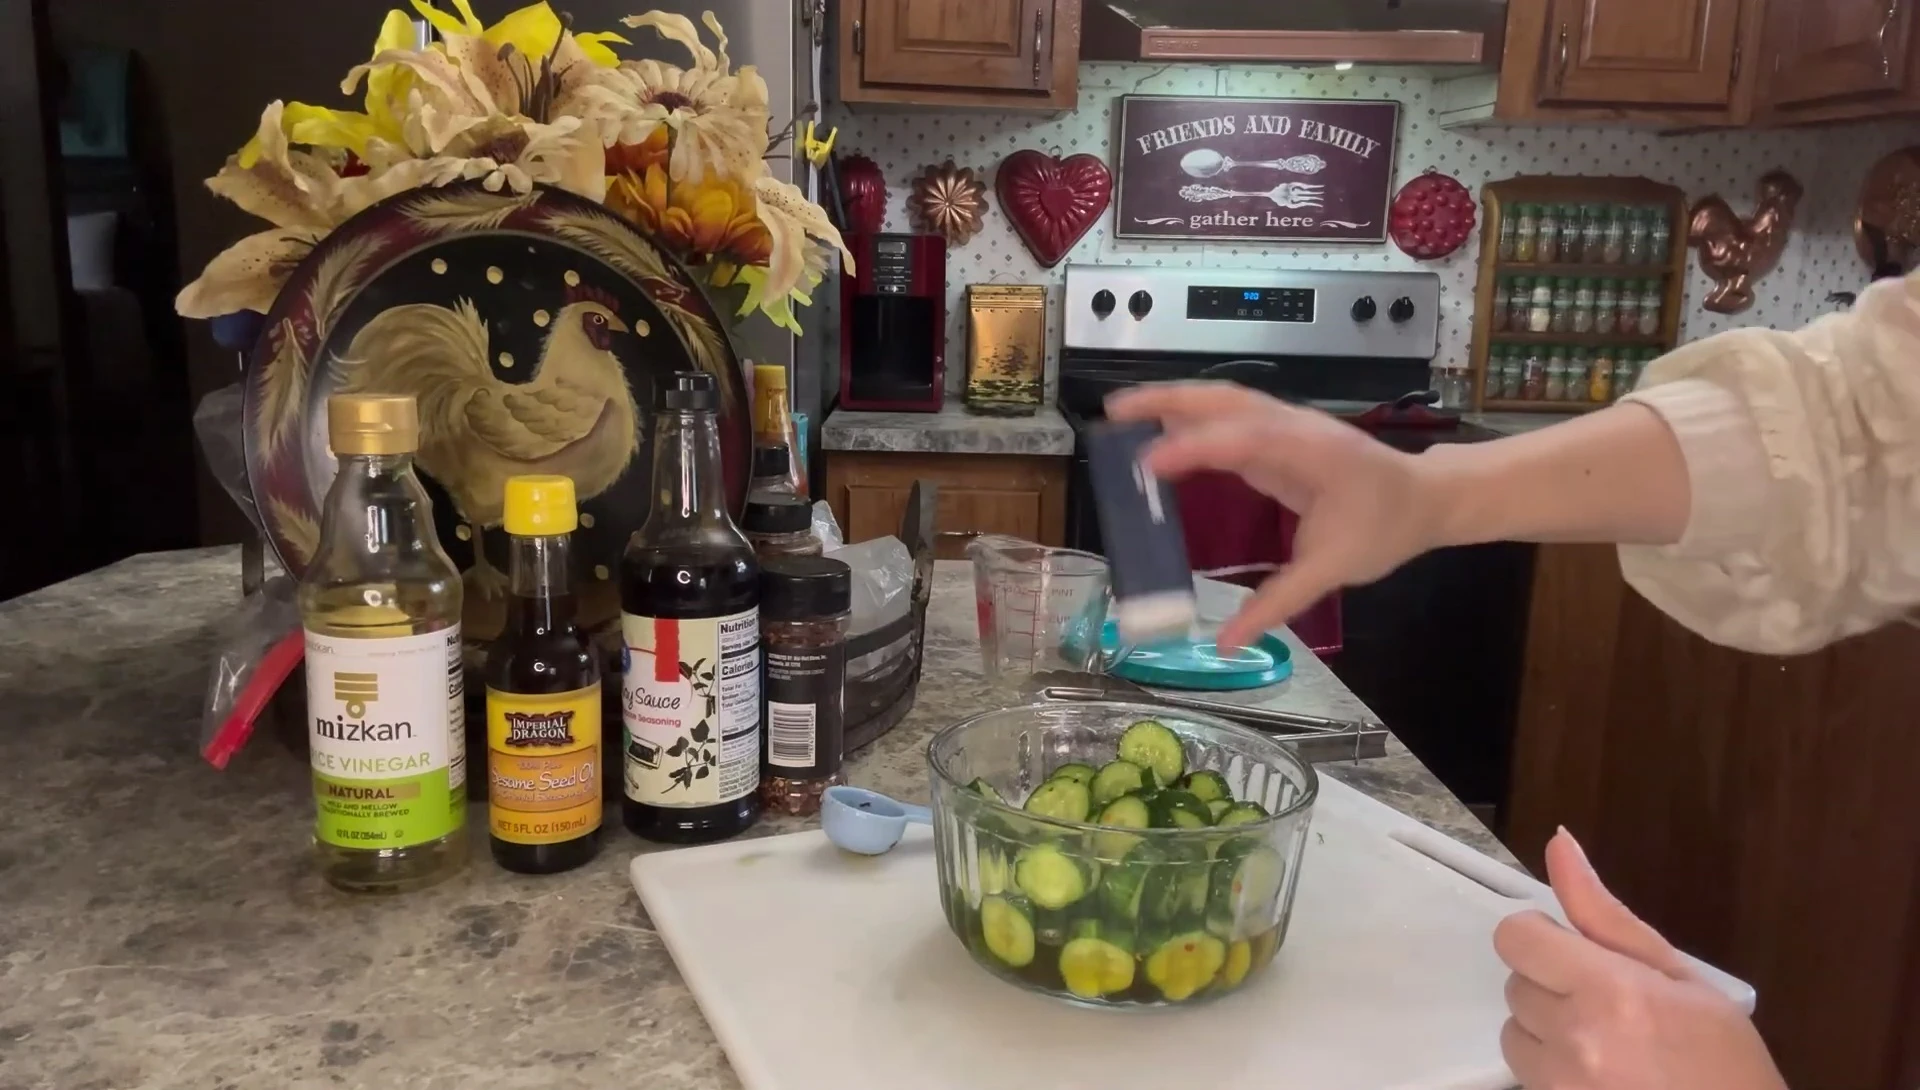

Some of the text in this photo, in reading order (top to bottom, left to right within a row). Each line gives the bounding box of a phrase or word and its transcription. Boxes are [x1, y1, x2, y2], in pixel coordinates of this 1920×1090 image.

[1136, 115, 1381, 158] FRIENDS AND FAMILY
[1190, 211, 1314, 229] gather here
[635, 687, 681, 709] Sauce
[316, 715, 412, 742] mizkan
[513, 716, 566, 729] IMPERIAL
[638, 713, 682, 728] Seasoning
[513, 728, 566, 740] DRAGON
[340, 752, 431, 773] VINEGAR
[491, 767, 536, 791] Sesame
[538, 766, 577, 791] Seed
[328, 784, 395, 800] NATURAL
[513, 822, 519, 832] 5
[520, 823, 531, 834] FL
[534, 823, 549, 834] OZ
